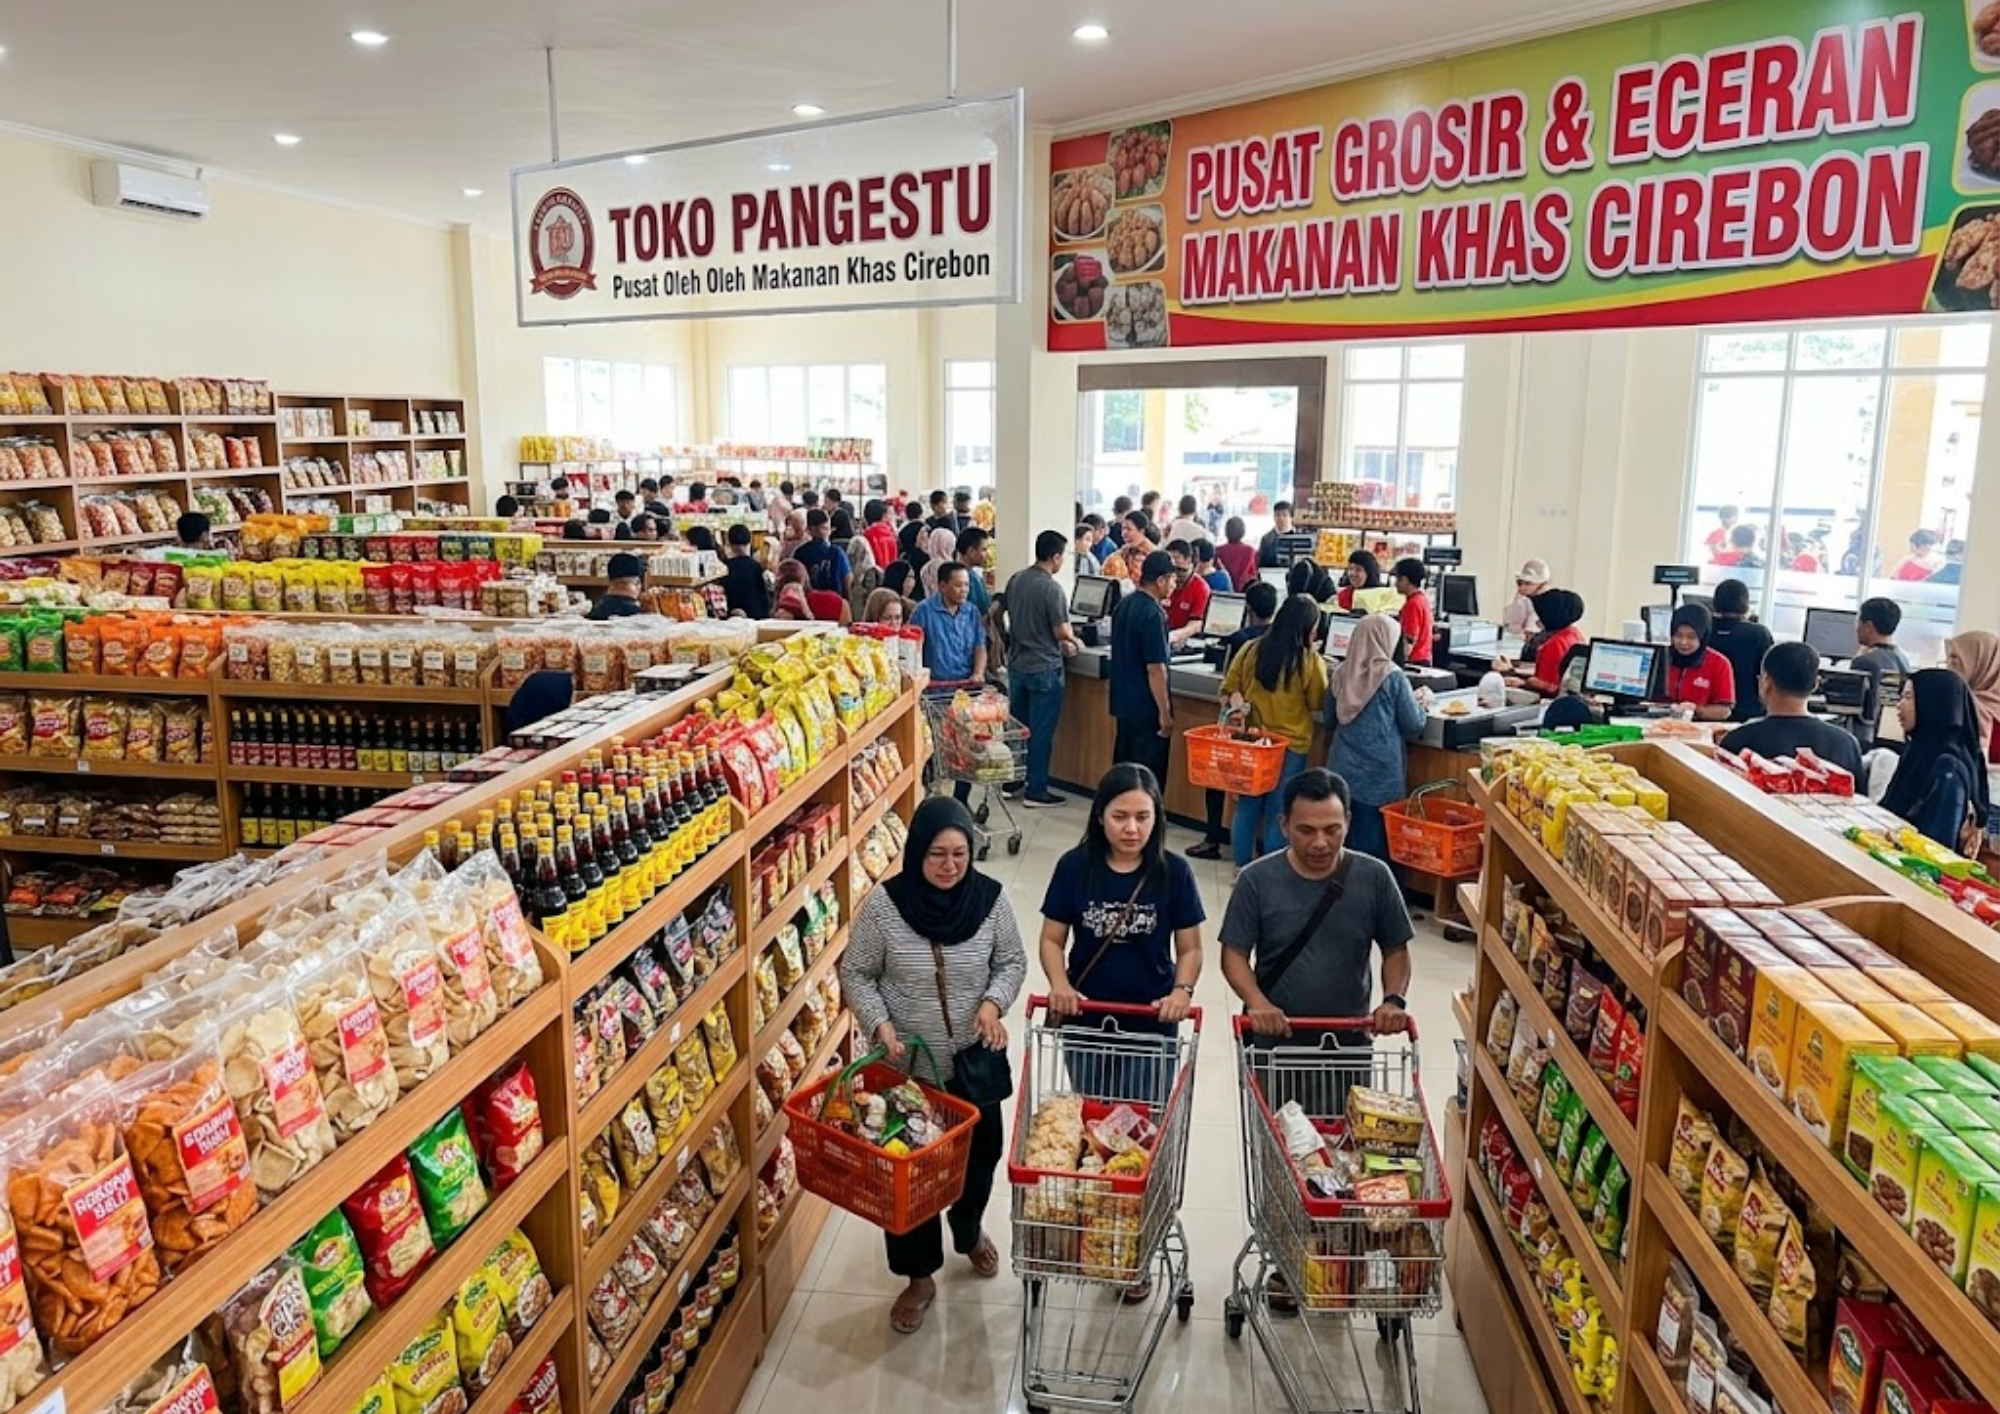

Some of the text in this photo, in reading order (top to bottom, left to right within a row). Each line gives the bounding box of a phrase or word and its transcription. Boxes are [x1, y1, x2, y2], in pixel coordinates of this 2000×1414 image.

[1187, 19, 1917, 212] PUSAT GROSIR & ECERAN
[608, 198, 715, 263] TOKO
[732, 162, 992, 254] PANGESTU
[613, 274, 659, 299] Pusat
[663, 269, 701, 296] Oleh
[706, 266, 746, 293] Oleh
[752, 262, 839, 290] Makanan
[847, 255, 896, 284] Khas
[904, 248, 990, 282] Cirebon
[1182, 149, 1922, 297] MAKANAN KHAS CIREBON
